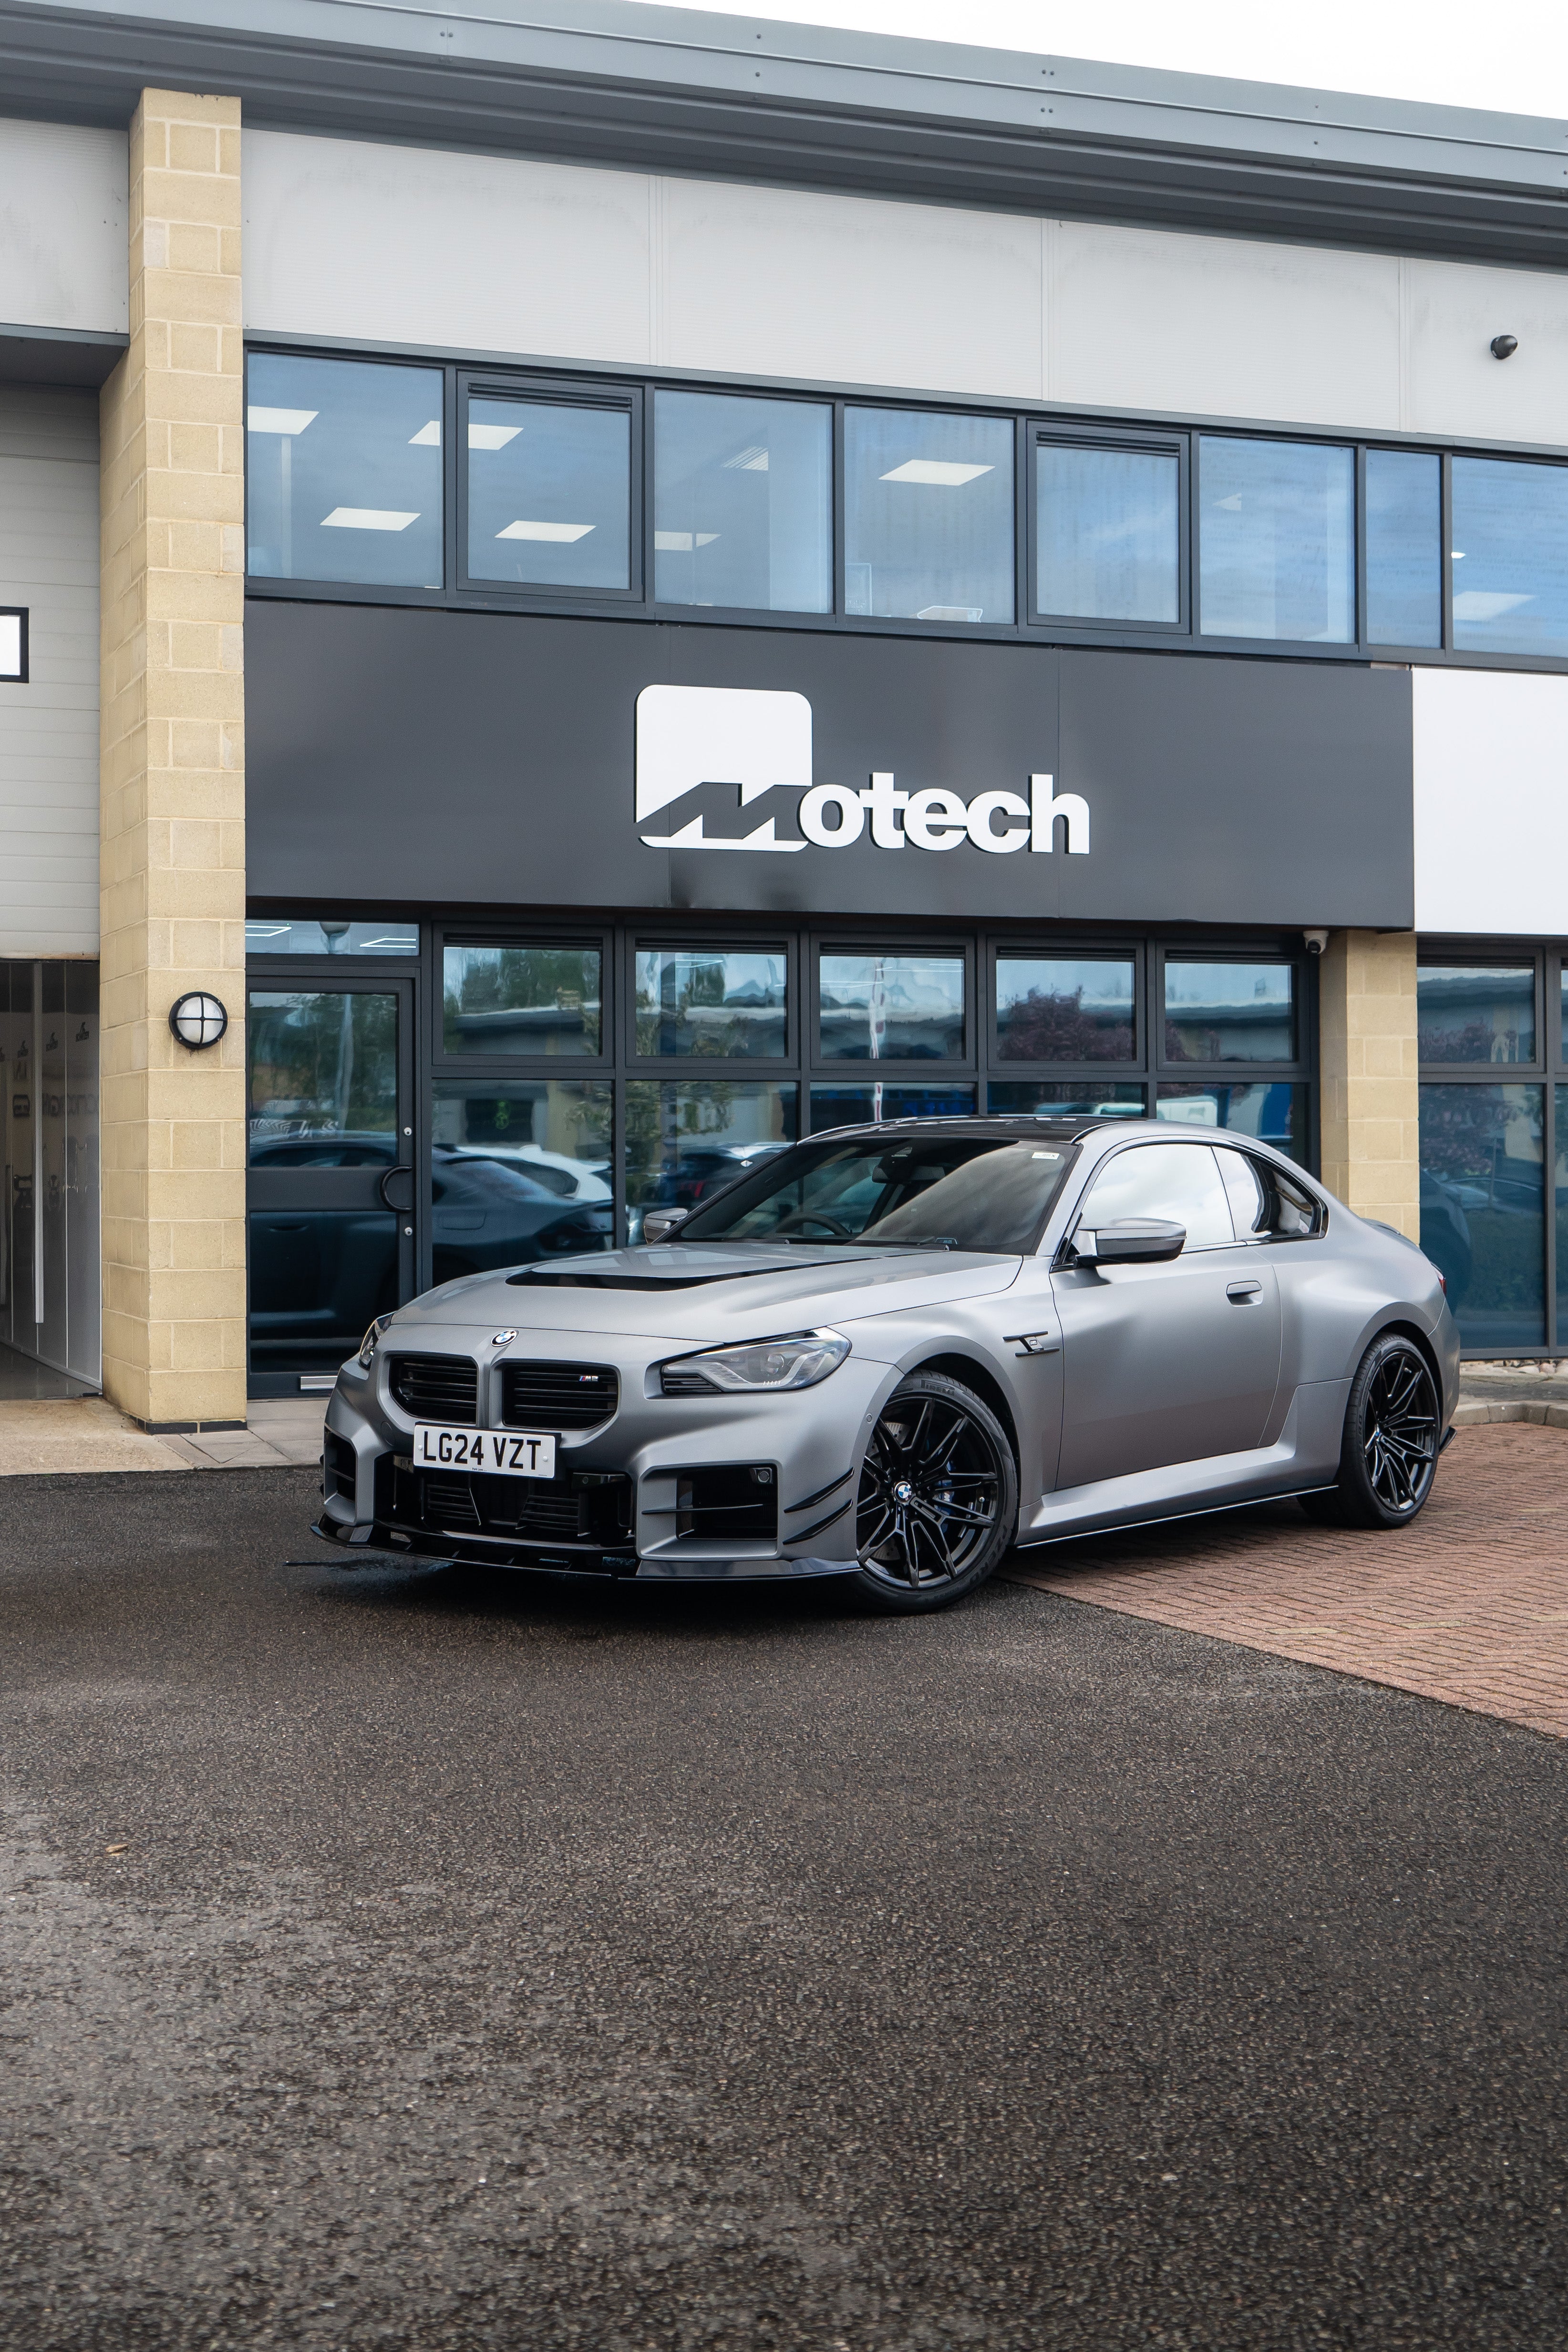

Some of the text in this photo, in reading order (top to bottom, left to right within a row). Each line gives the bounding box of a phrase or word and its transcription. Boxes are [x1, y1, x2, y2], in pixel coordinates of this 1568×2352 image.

[635, 684, 1090, 855] Motech
[423, 1431, 541, 1470] LG24 VZT
